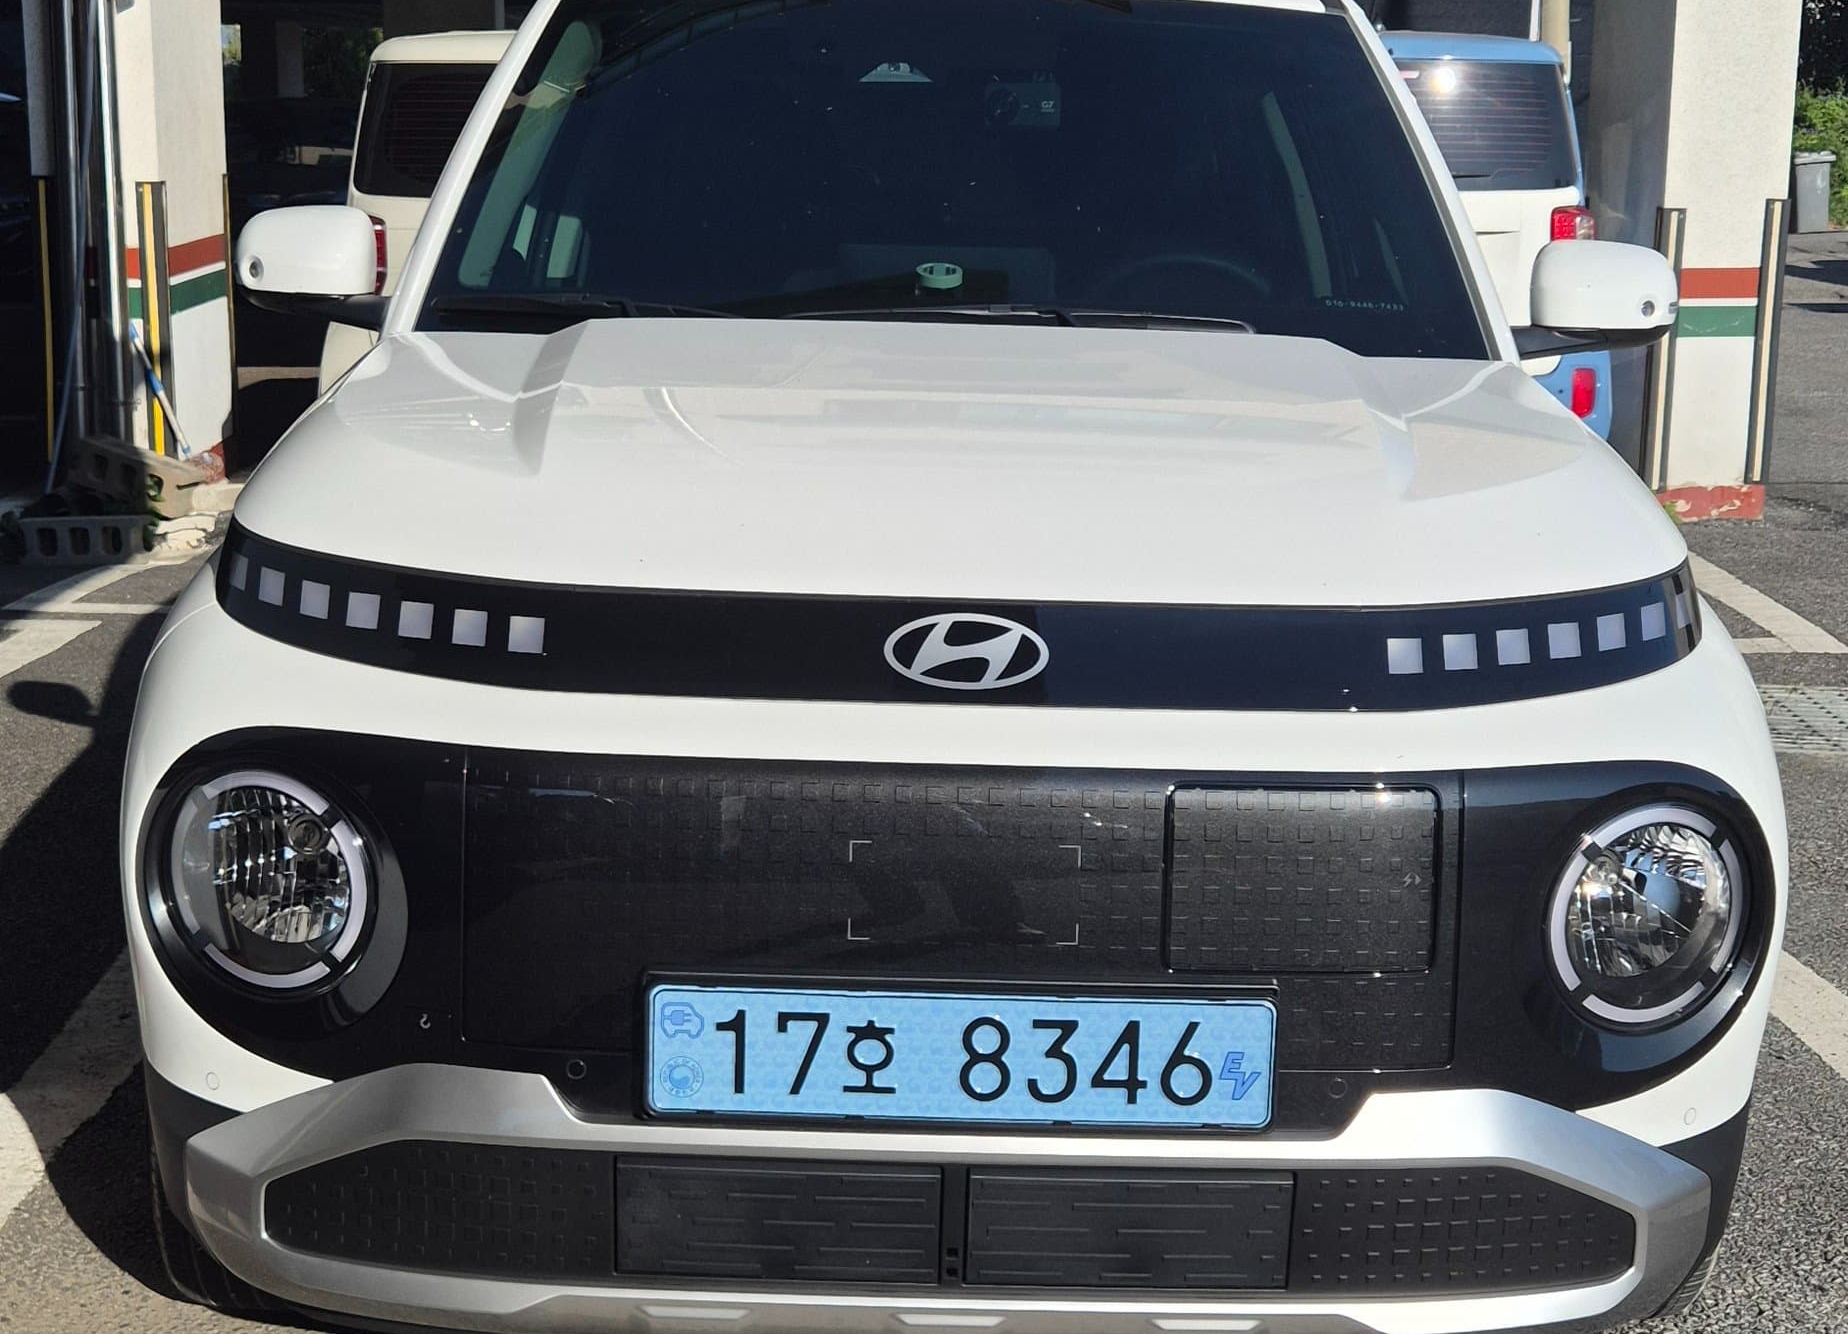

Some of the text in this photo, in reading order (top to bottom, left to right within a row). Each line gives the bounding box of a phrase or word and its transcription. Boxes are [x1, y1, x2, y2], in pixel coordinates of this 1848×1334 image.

[715, 1008, 897, 1095] 17호
[958, 1015, 1214, 1107] 8346
[1219, 1051, 1261, 1101] EV
